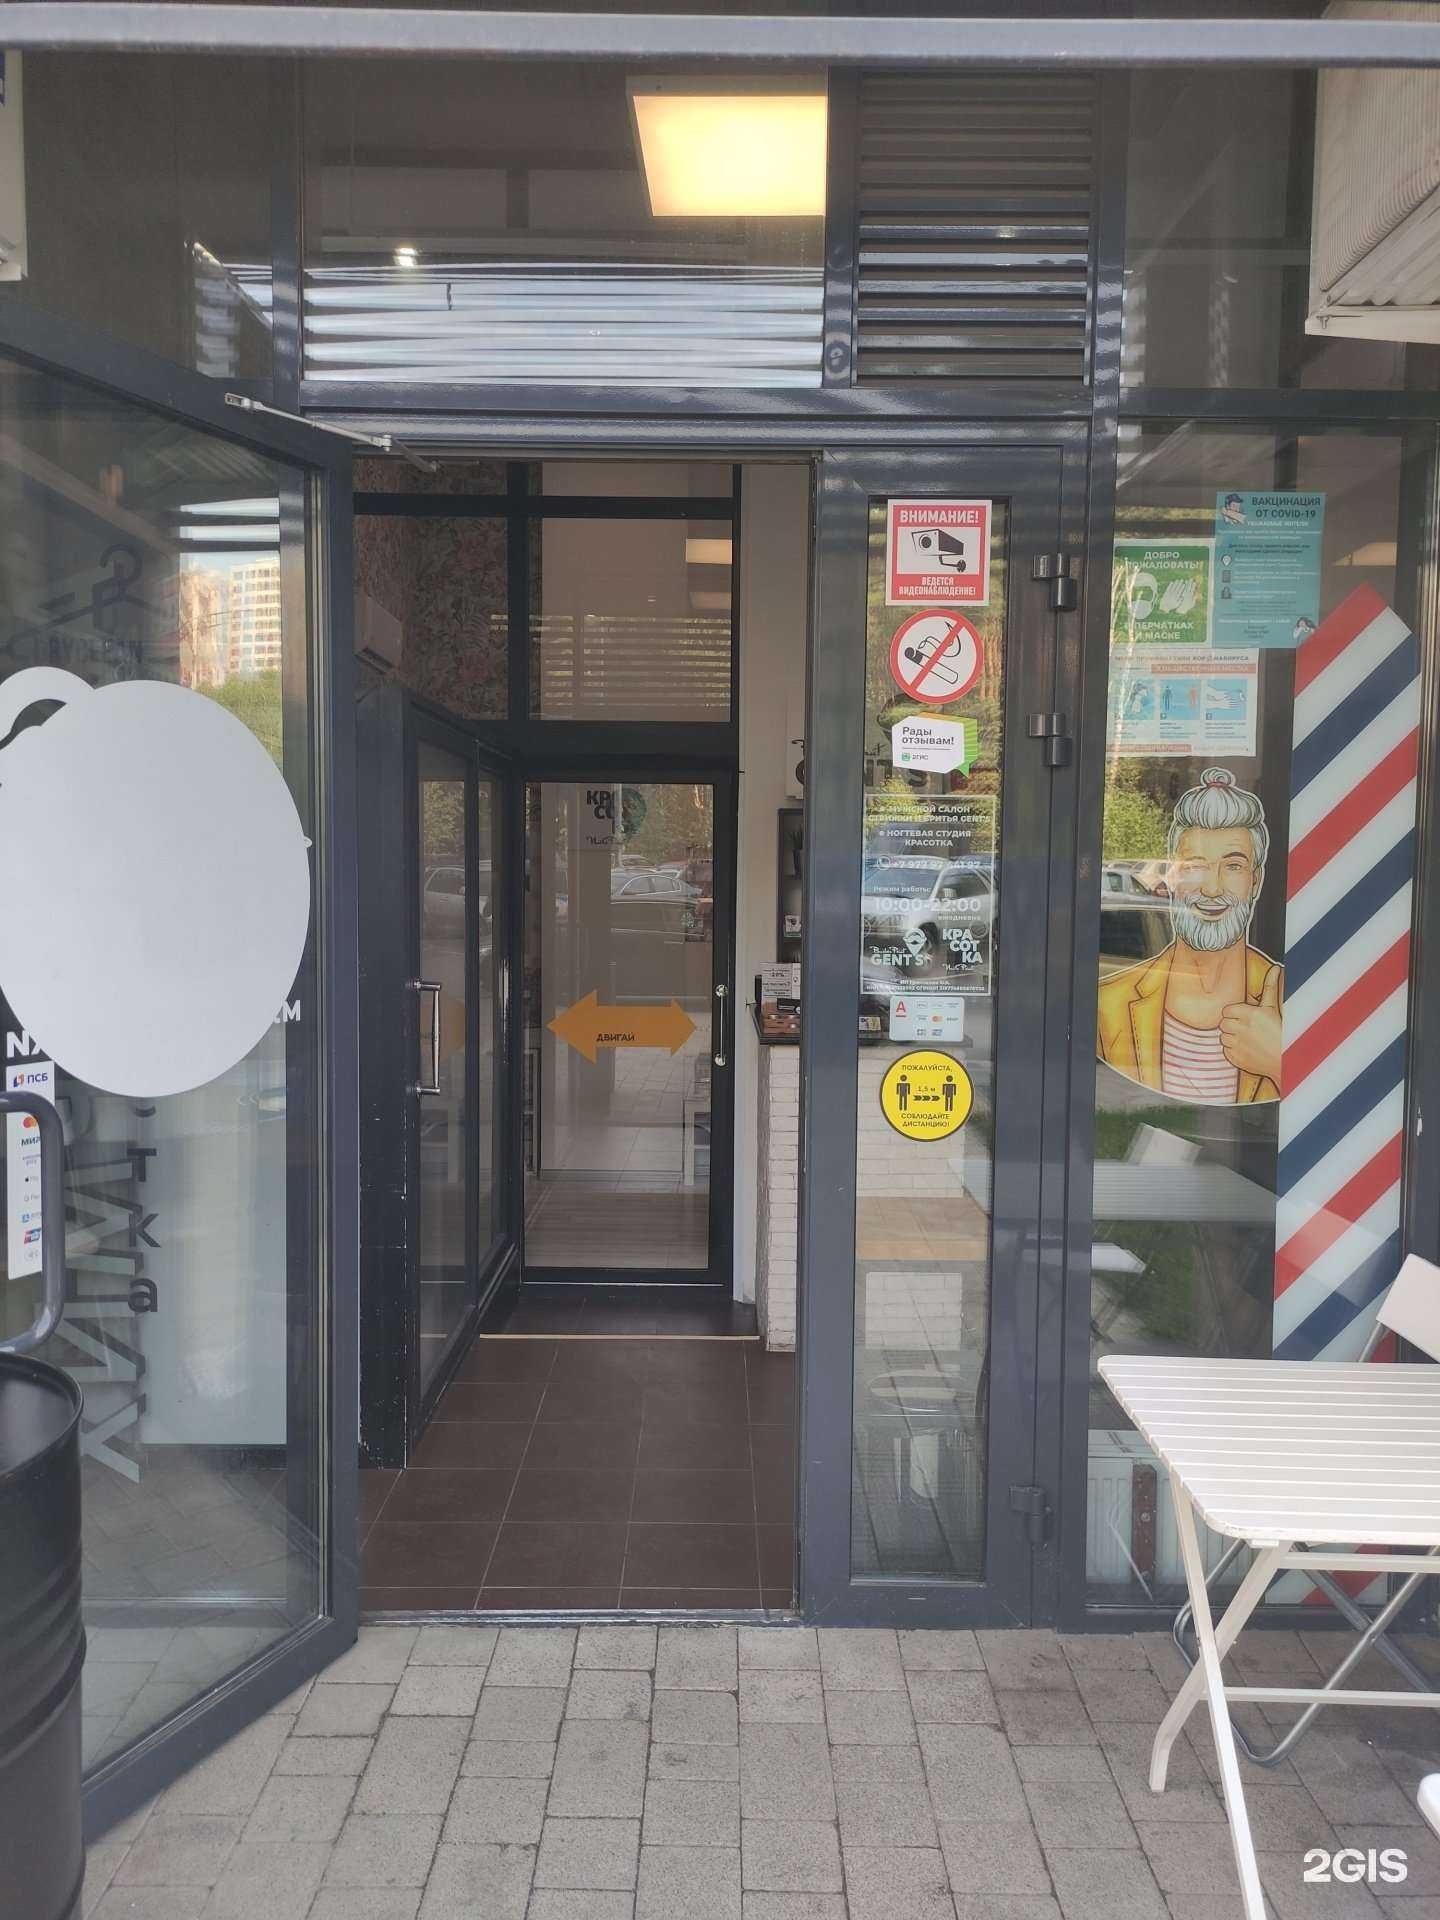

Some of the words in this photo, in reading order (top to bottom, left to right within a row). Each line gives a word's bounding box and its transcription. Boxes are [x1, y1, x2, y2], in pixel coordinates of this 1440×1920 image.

[1251, 496, 1321, 506] ВАКЦИНАЦИЯ
[900, 510, 979, 523] ВНИМАНИЕ!
[1255, 510, 1270, 518] ОТ
[1271, 510, 1316, 518] COVID-19
[1143, 551, 1180, 560] ДОБРО
[922, 577, 954, 585] ВЕДЕТСЯ
[899, 586, 976, 596] ВИДЕОНАБЛЮДЕНИЕ!
[1135, 621, 1194, 630] ПЕРЧАТКАХ
[1145, 631, 1181, 640] МАСКЕ
[902, 727, 932, 737] Рады
[902, 736, 955, 745] отзывам!
[938, 805, 970, 813] САЛОН
[935, 830, 971, 838] СТУДИЯ
[904, 839, 954, 847] КРАСОТКА
[942, 928, 973, 940] КРА
[950, 940, 980, 952] СОТ
[961, 951, 983, 963] КА
[596, 1033, 635, 1042] ДВИГАЙ
[901, 1064, 953, 1073] ПОЖАЛУЙСТА,
[27, 1072, 48, 1084] ПСБ
[901, 1112, 950, 1120] СОБЛЮДАЙТЕ
[902, 1120, 950, 1128] ДИСТАНЦИЮ!
